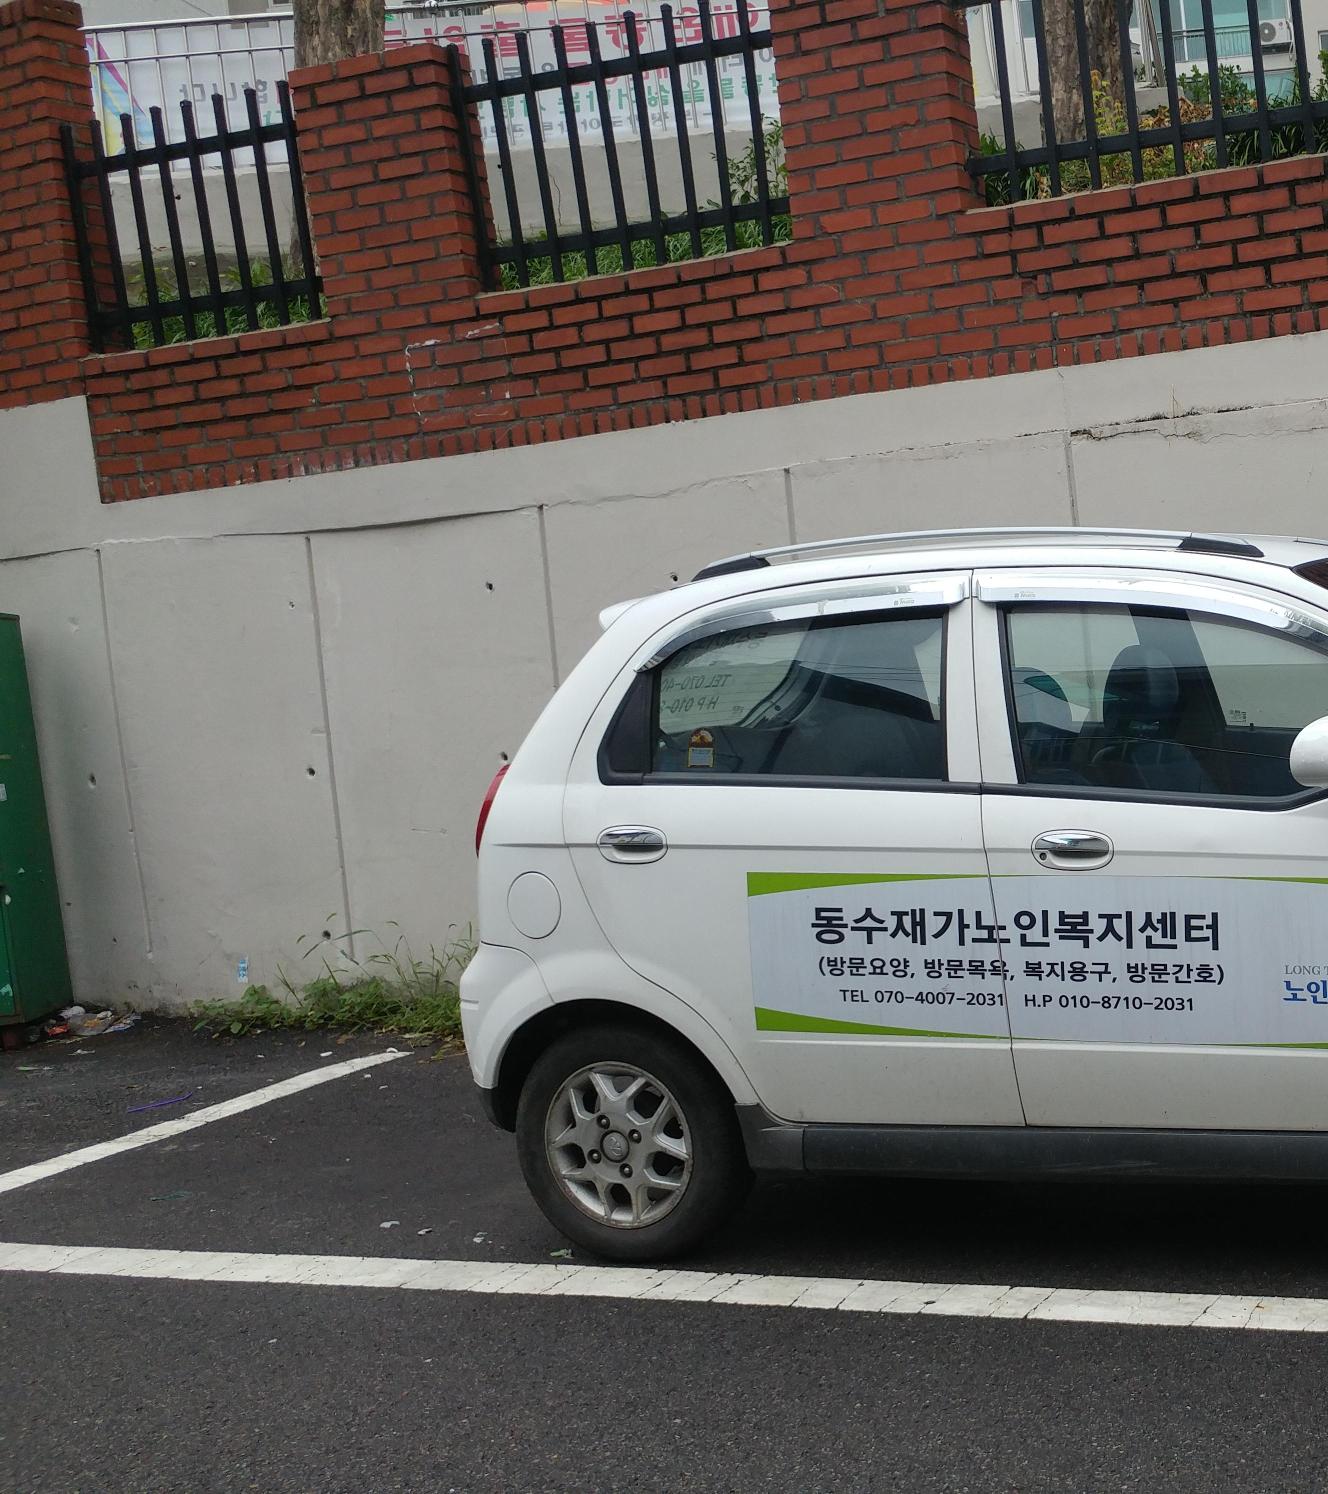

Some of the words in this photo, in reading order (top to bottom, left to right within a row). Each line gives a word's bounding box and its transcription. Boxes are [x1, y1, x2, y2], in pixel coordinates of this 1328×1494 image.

[811, 907, 1219, 951] 동수재가노인복지센터
[818, 956, 916, 979] (방문요양,
[923, 958, 1015, 981] 방문목욕,
[1023, 960, 1117, 983] 복지용구,
[1126, 962, 1225, 985] 방문간호)
[1284, 964, 1321, 976] LONG
[839, 989, 869, 1003] TEL
[874, 990, 1005, 1007] 070-4007-2031
[1024, 993, 1053, 1008] H.P
[1058, 994, 1194, 1012] 010-8710-2031
